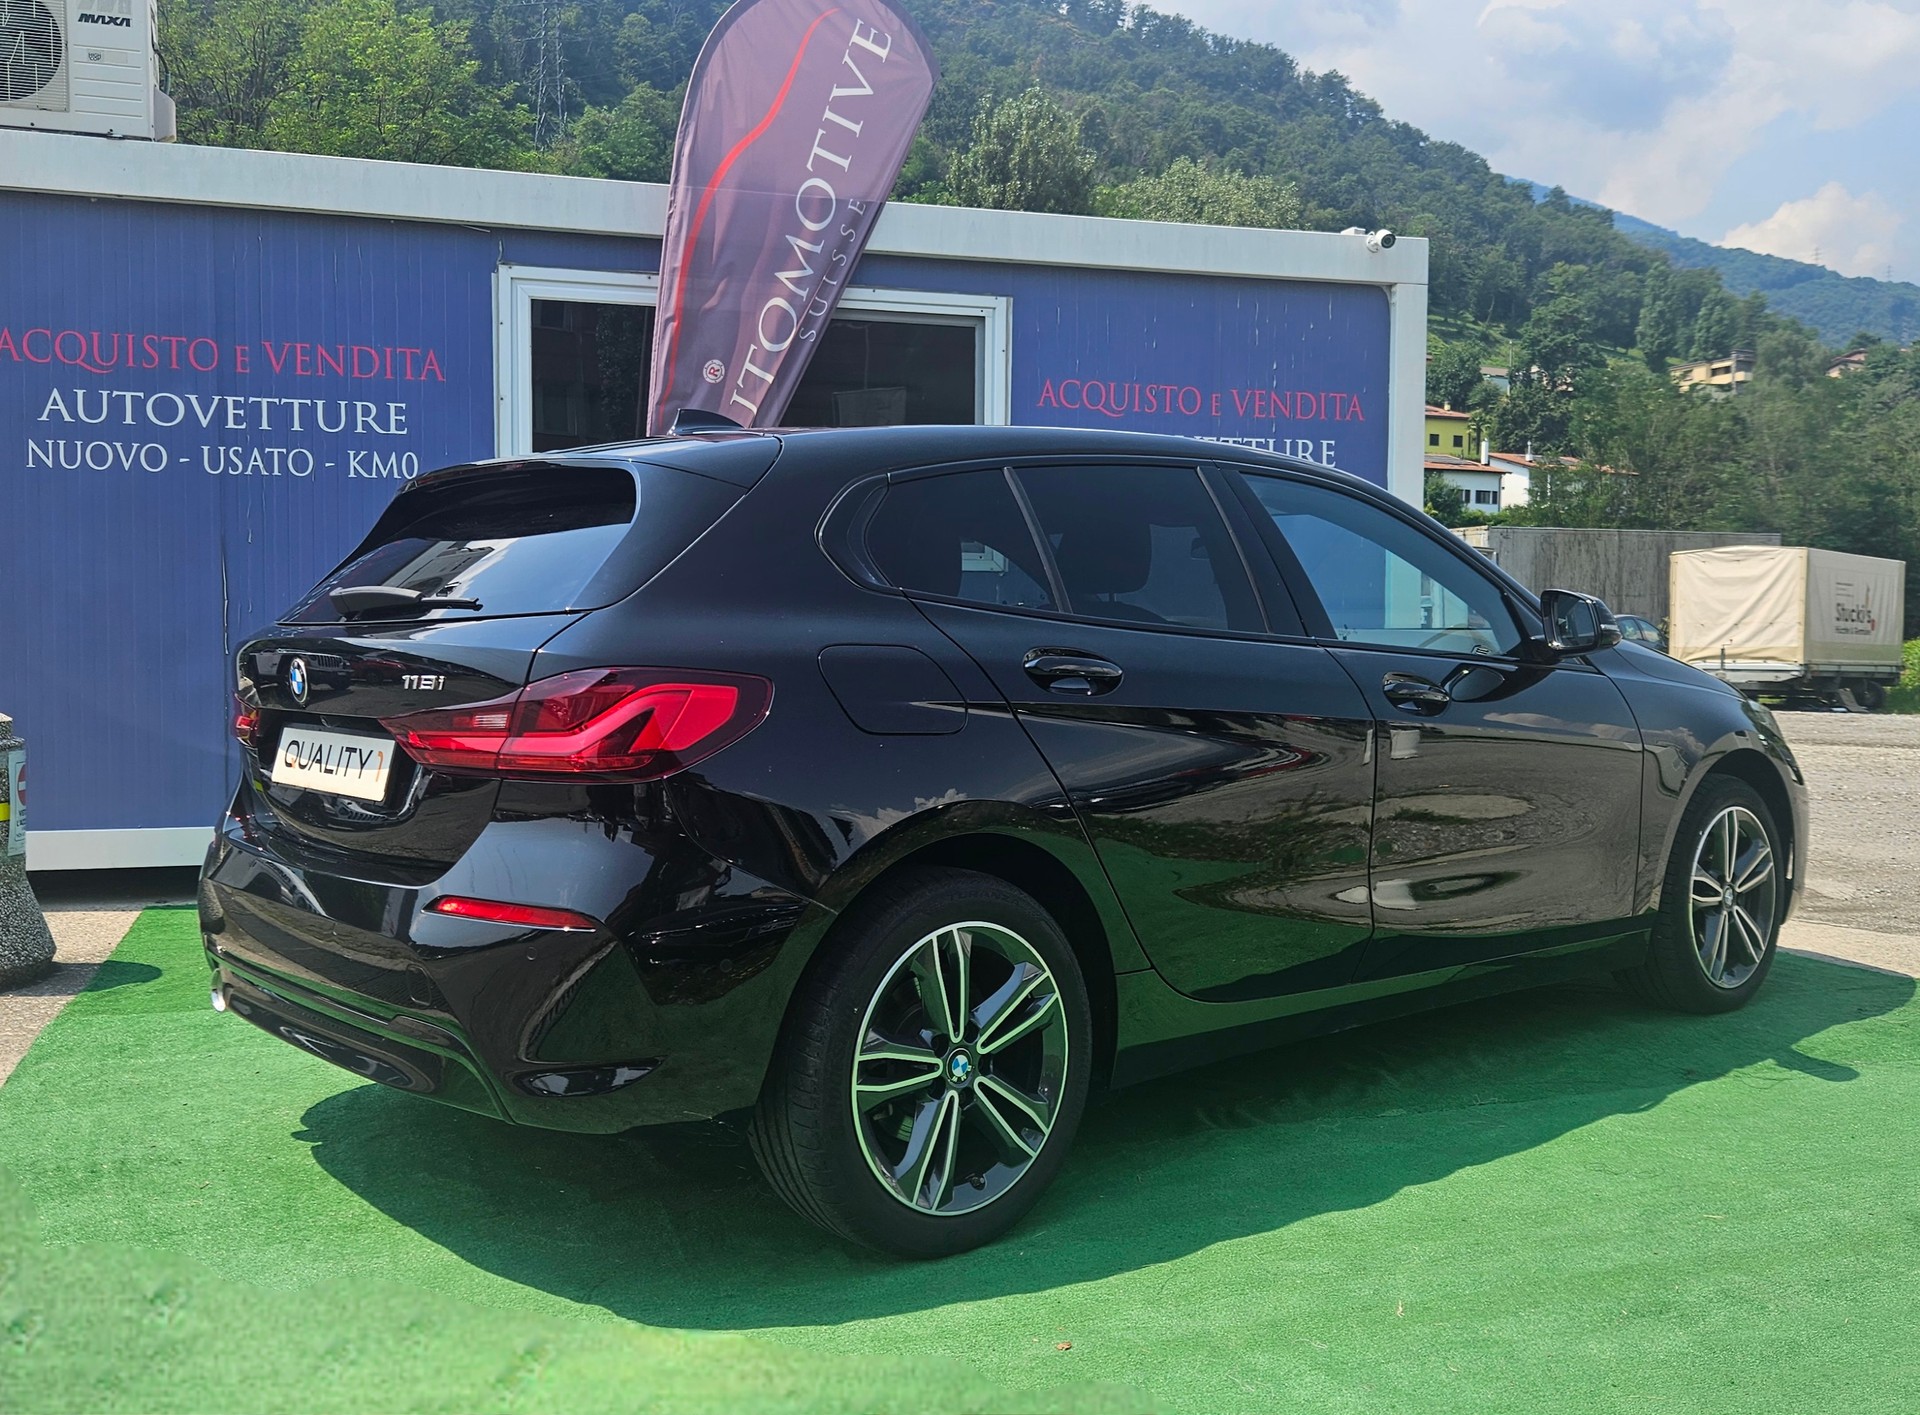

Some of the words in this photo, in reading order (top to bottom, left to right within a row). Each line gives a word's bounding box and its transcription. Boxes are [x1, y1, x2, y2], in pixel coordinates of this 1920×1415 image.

[78, 13, 131, 27] MAXA
[798, 197, 868, 343] SUISSE
[0, 326, 219, 374] ACQUISTO
[262, 340, 447, 382] VENDITA
[37, 387, 409, 435] AUTOVETTURE
[1036, 378, 1202, 418] ACQUISTO
[1229, 388, 1366, 421] VENDITA
[25, 438, 168, 472] NUOVO
[201, 444, 315, 477] USATO
[347, 450, 420, 480] KM0
[401, 673, 447, 691] 118i
